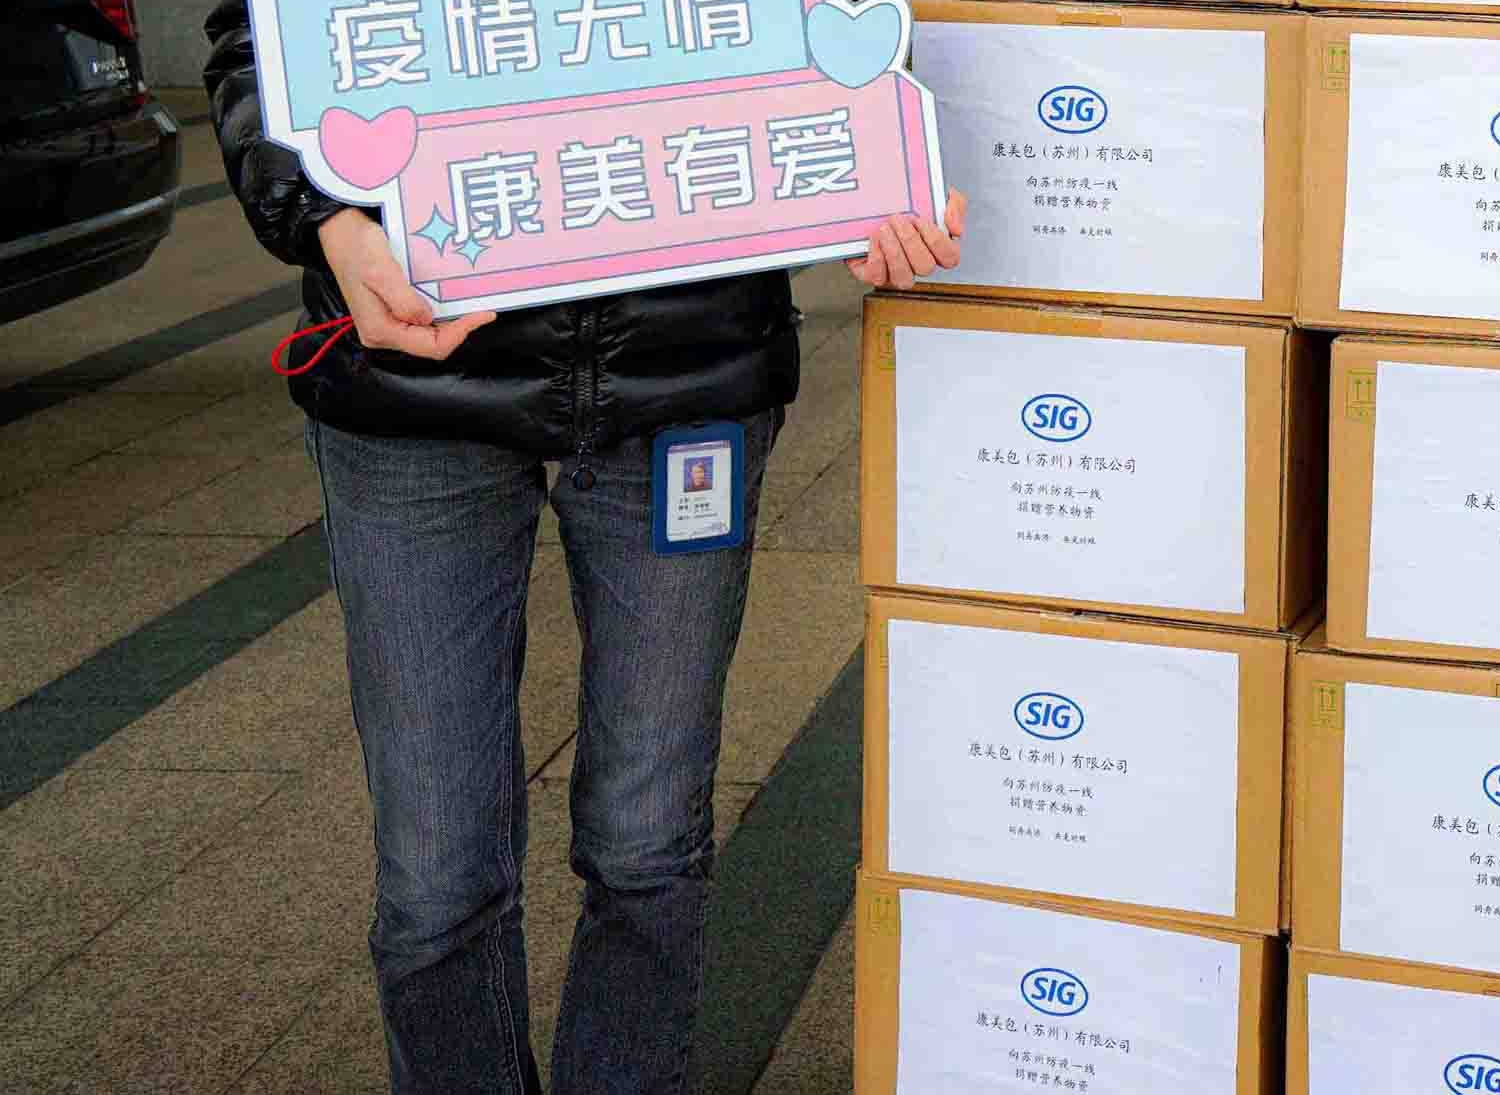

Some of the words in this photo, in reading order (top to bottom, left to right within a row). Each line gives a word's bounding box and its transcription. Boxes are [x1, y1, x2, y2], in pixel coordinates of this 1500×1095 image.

[1048, 95, 1095, 123] SIG
[991, 141, 1153, 163] 康美包（苏州）有限公司
[446, 108, 859, 248] 康美有爱
[1025, 175, 1119, 191] 向苏州防疫一线
[1031, 403, 1080, 433] SIG
[976, 447, 1136, 474] 康美包（苏州）有限公司
[1010, 481, 1102, 503] 向苏州防疫一线
[1023, 701, 1073, 730] SIG
[969, 743, 1128, 775] 康美包（苏州）有限公司
[1003, 776, 1093, 800] 向苏州防疫一线
[1030, 976, 1078, 1007] SIG
[975, 1011, 1130, 1055] 康美包（苏州）有限公司
